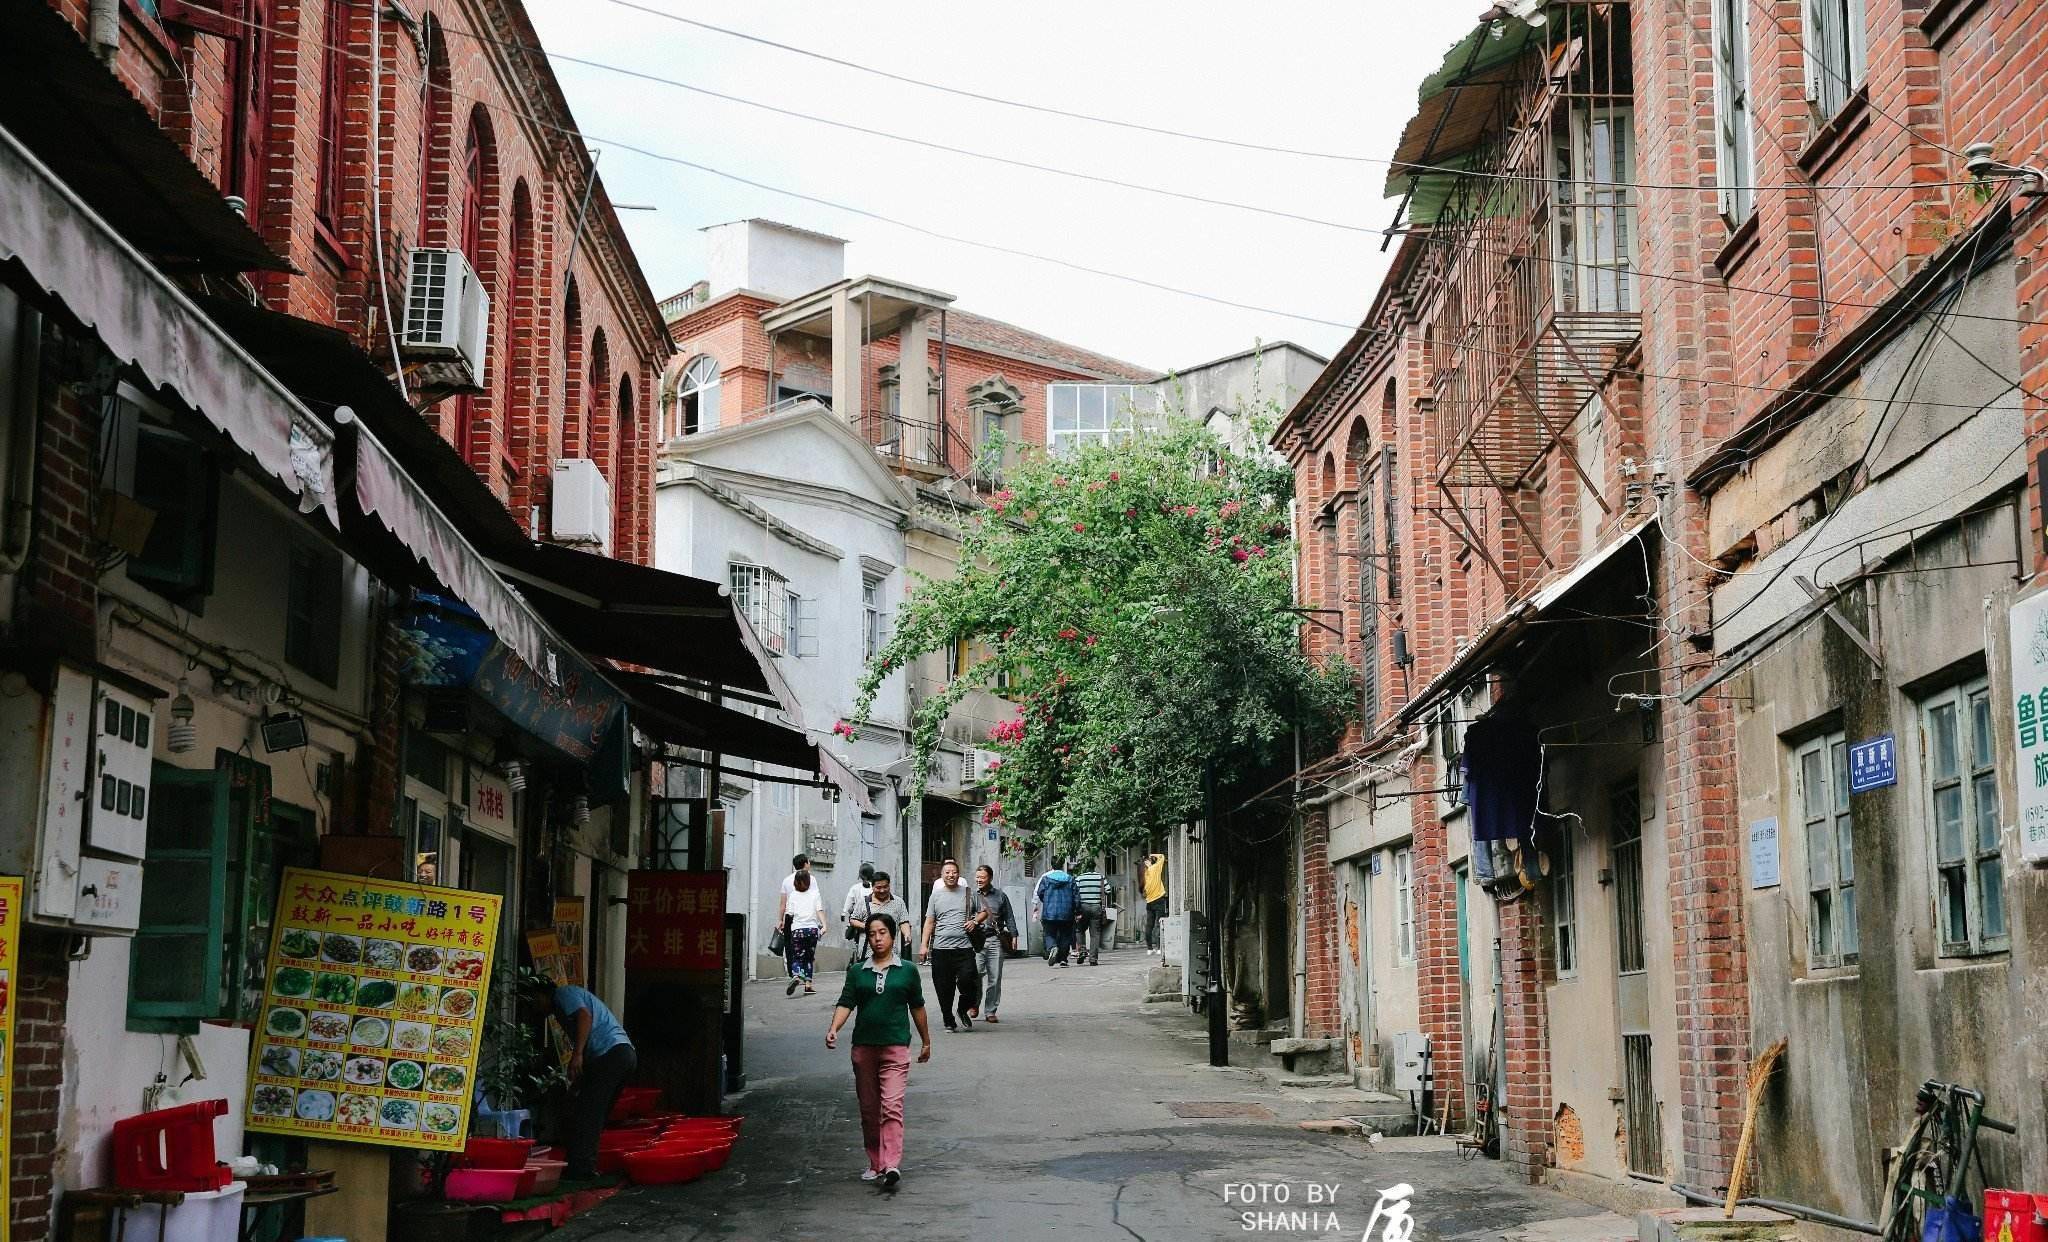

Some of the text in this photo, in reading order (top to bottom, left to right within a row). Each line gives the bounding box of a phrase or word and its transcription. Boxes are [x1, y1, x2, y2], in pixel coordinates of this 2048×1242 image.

[478, 783, 504, 821] 大排档
[2028, 824, 2048, 842] 巷内
[294, 883, 487, 924] 大众点评鼓新路1号
[631, 886, 719, 915] 平价海鲜
[425, 925, 485, 947] 好评商家
[630, 927, 718, 957] 大排档
